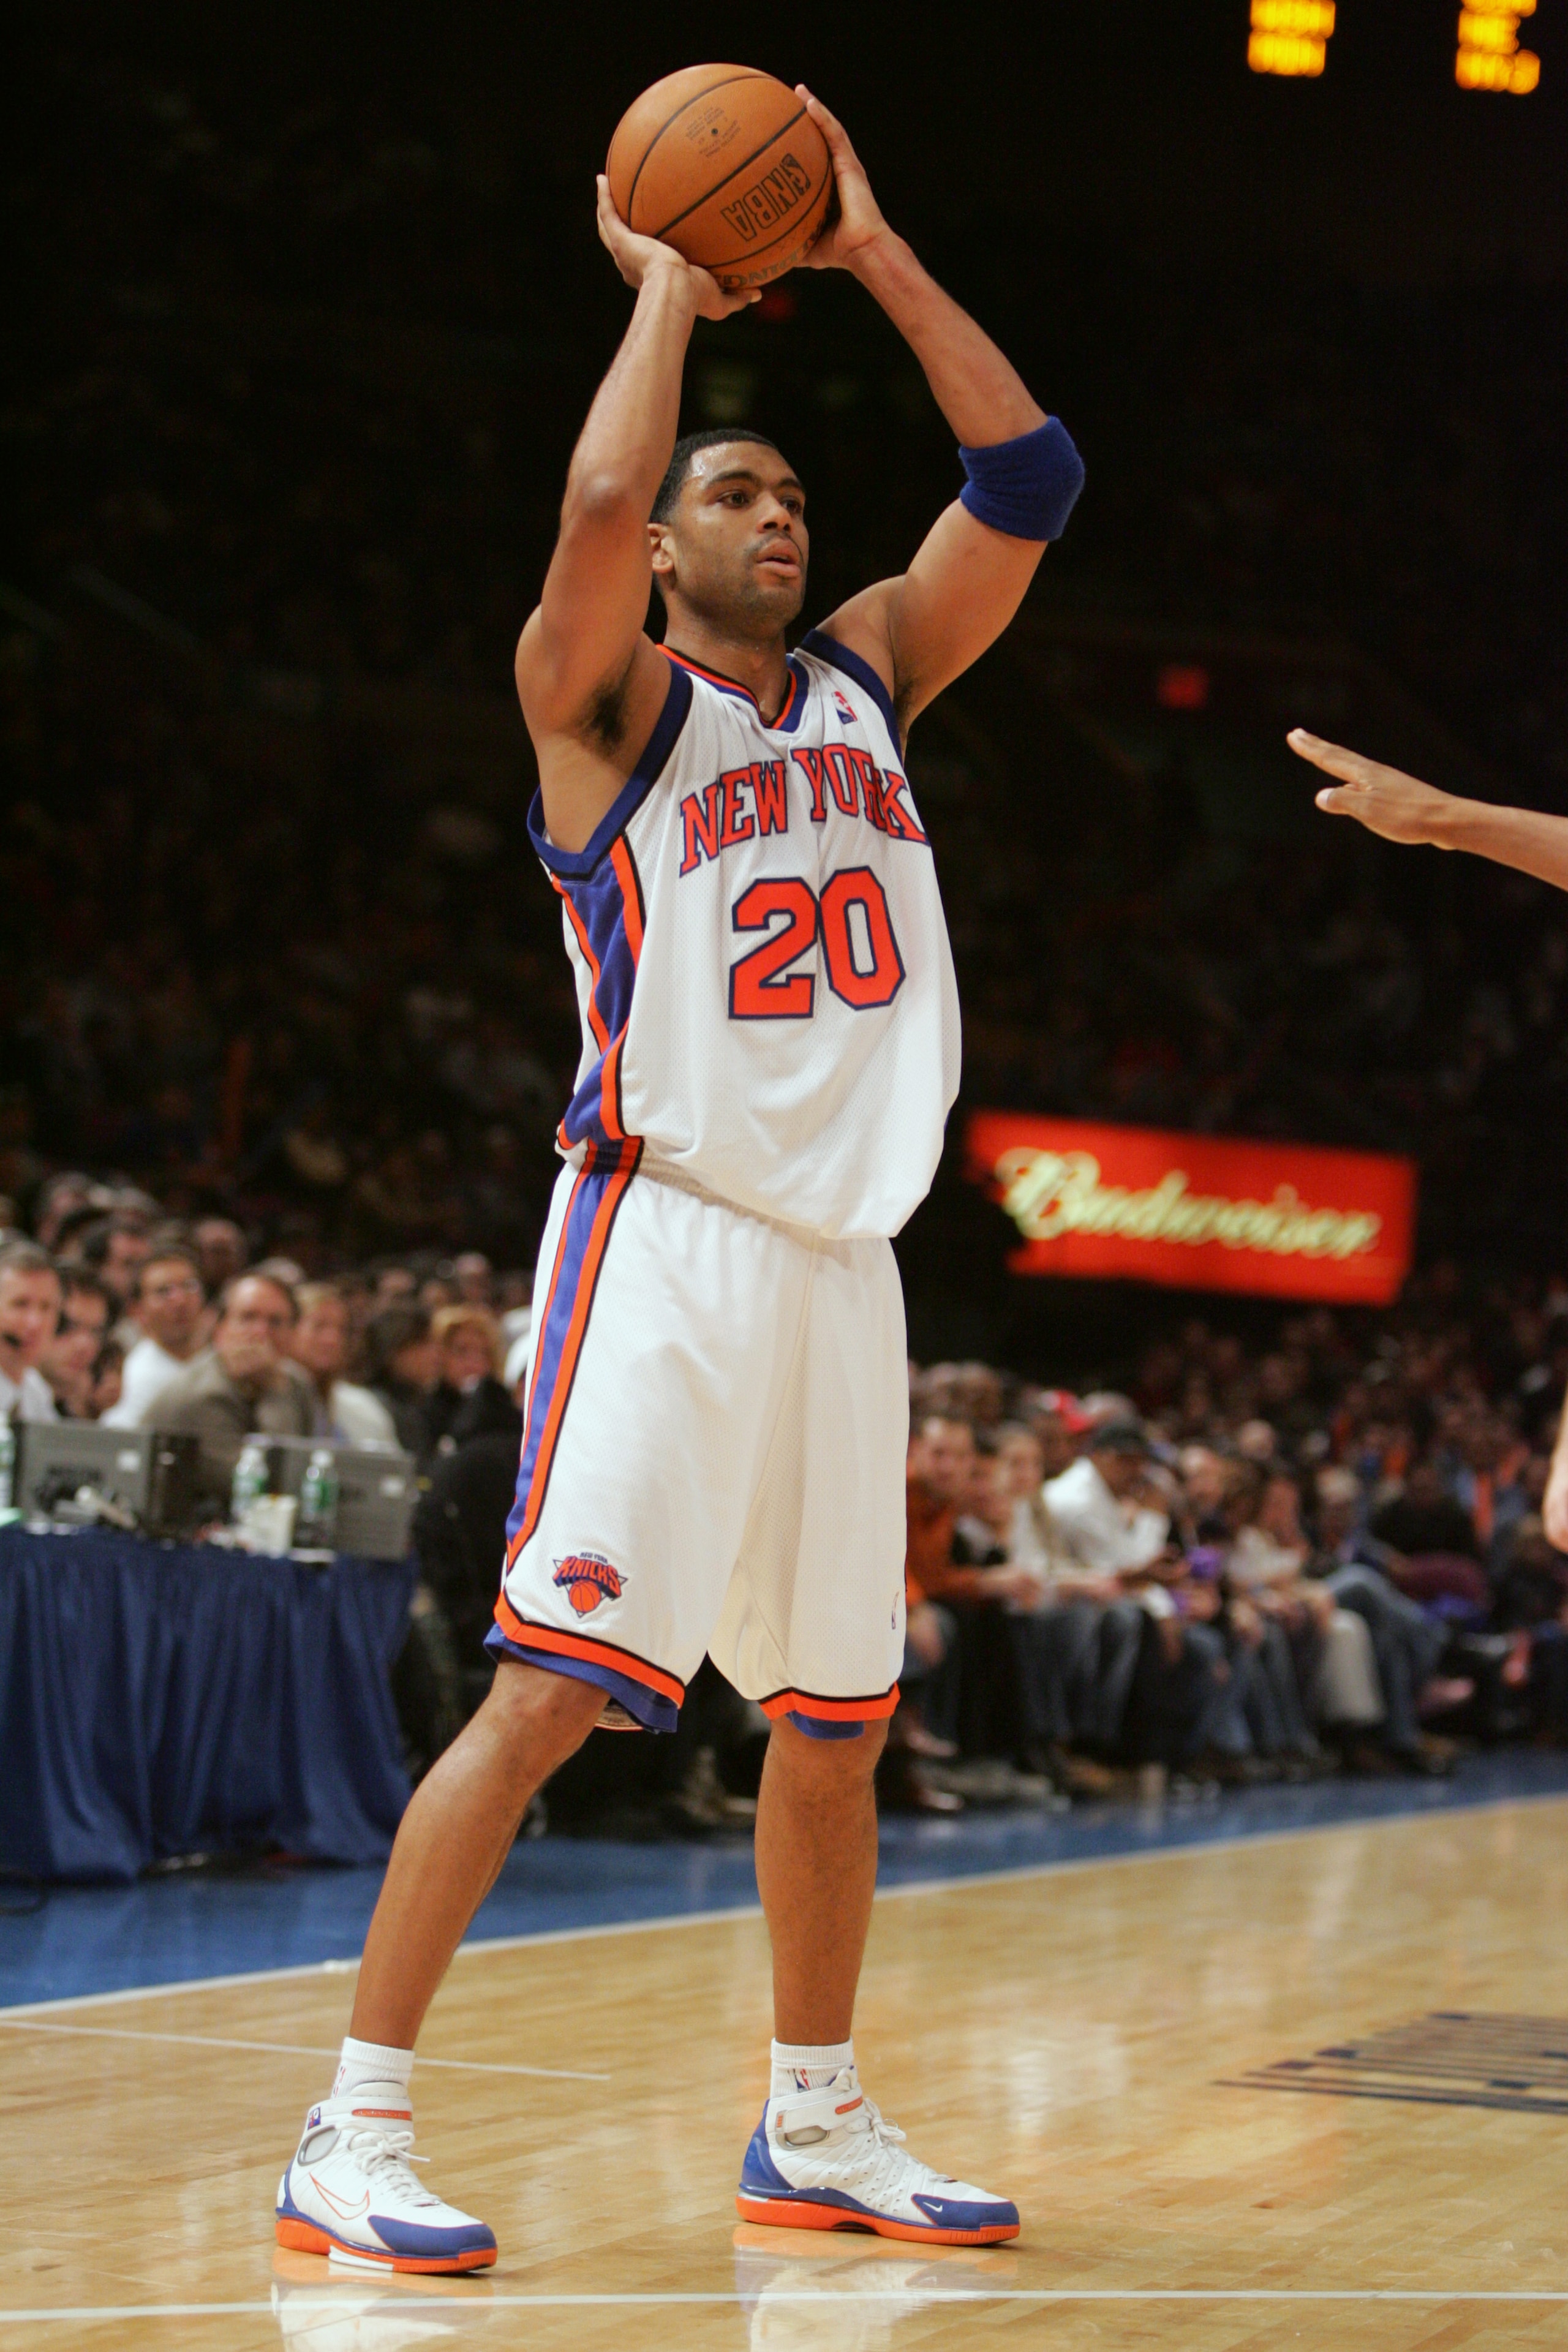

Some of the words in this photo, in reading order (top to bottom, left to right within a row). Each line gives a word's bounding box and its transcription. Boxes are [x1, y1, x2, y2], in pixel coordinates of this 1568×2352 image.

[720, 167, 799, 242] NBA
[679, 760, 788, 877] NEW
[790, 743, 932, 848] YORK
[728, 865, 907, 1020] 20
[552, 1556, 622, 1600] KNICKS
[594, 1553, 608, 1564] YORK
